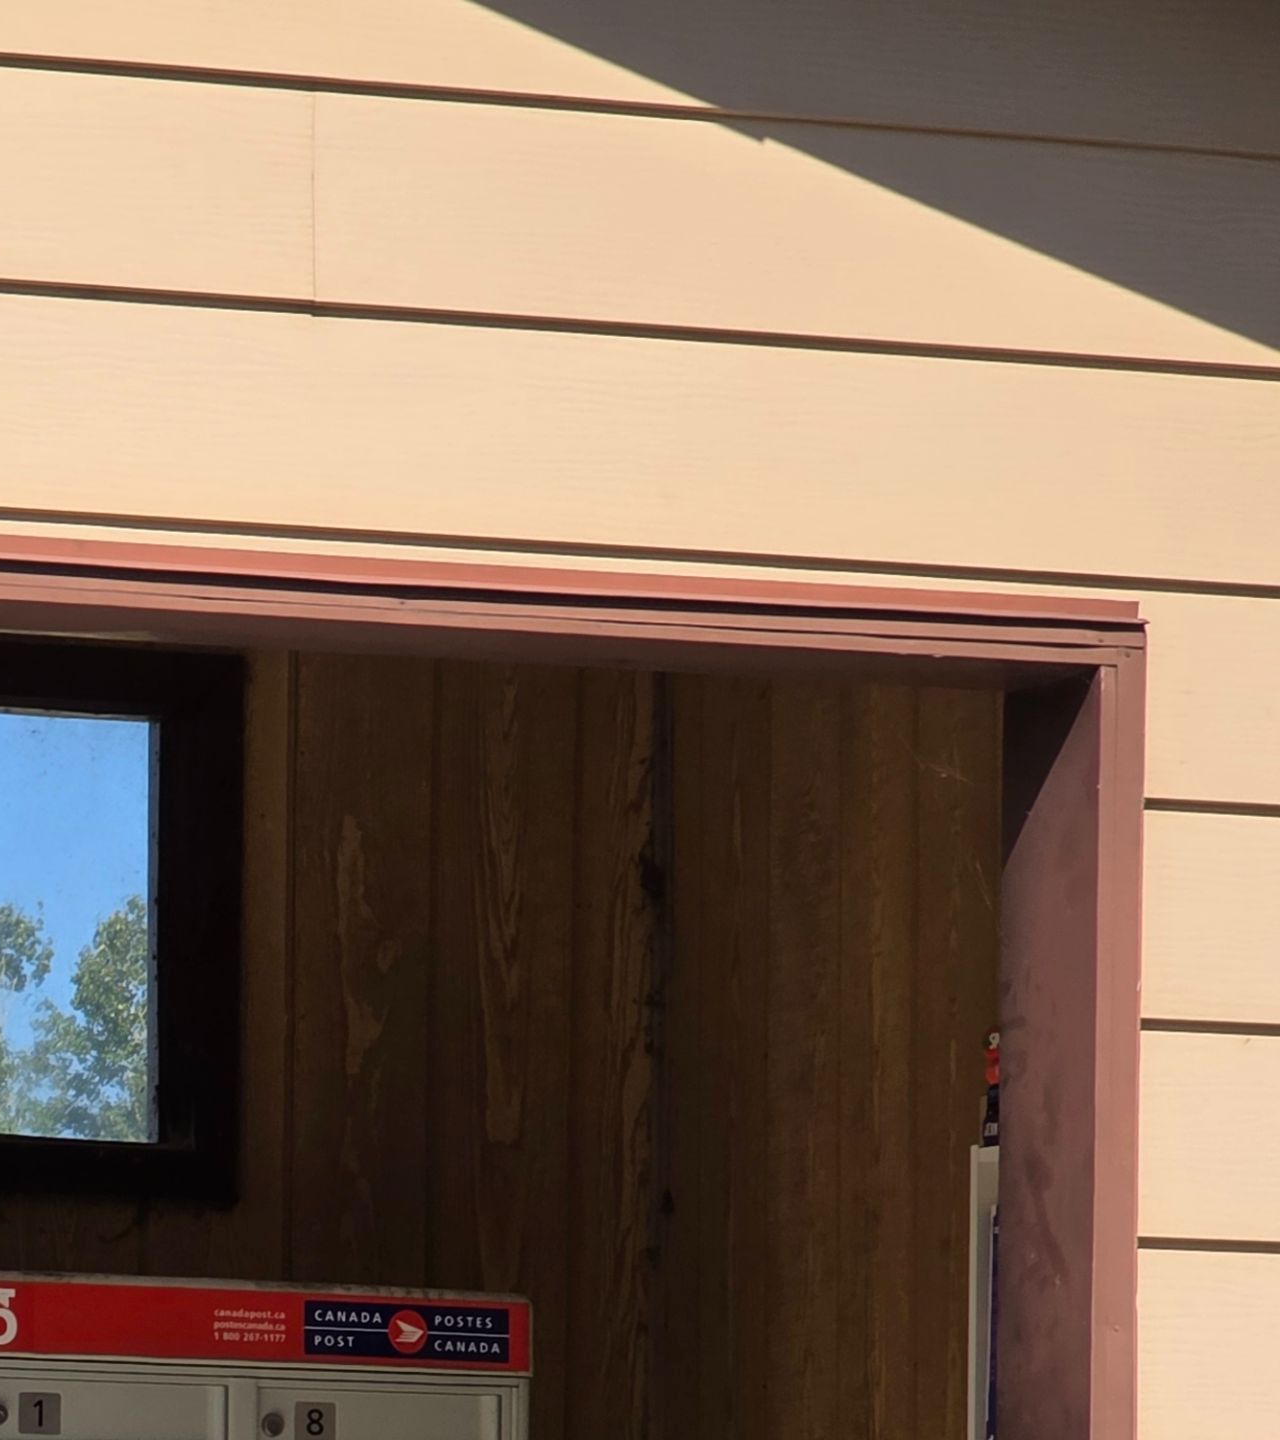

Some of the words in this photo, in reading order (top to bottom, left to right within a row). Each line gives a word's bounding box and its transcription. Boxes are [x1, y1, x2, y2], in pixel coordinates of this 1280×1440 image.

[214, 1307, 286, 1320] canadapost.ca
[314, 1309, 382, 1324] CANADA
[434, 1315, 494, 1329] POSTES
[222, 1332, 241, 1342] 800
[243, 1332, 286, 1343] 267-1177
[314, 1335, 355, 1348] POST
[434, 1339, 501, 1354] CANADA
[33, 1399, 44, 1428] 1
[306, 1408, 325, 1436] 8
